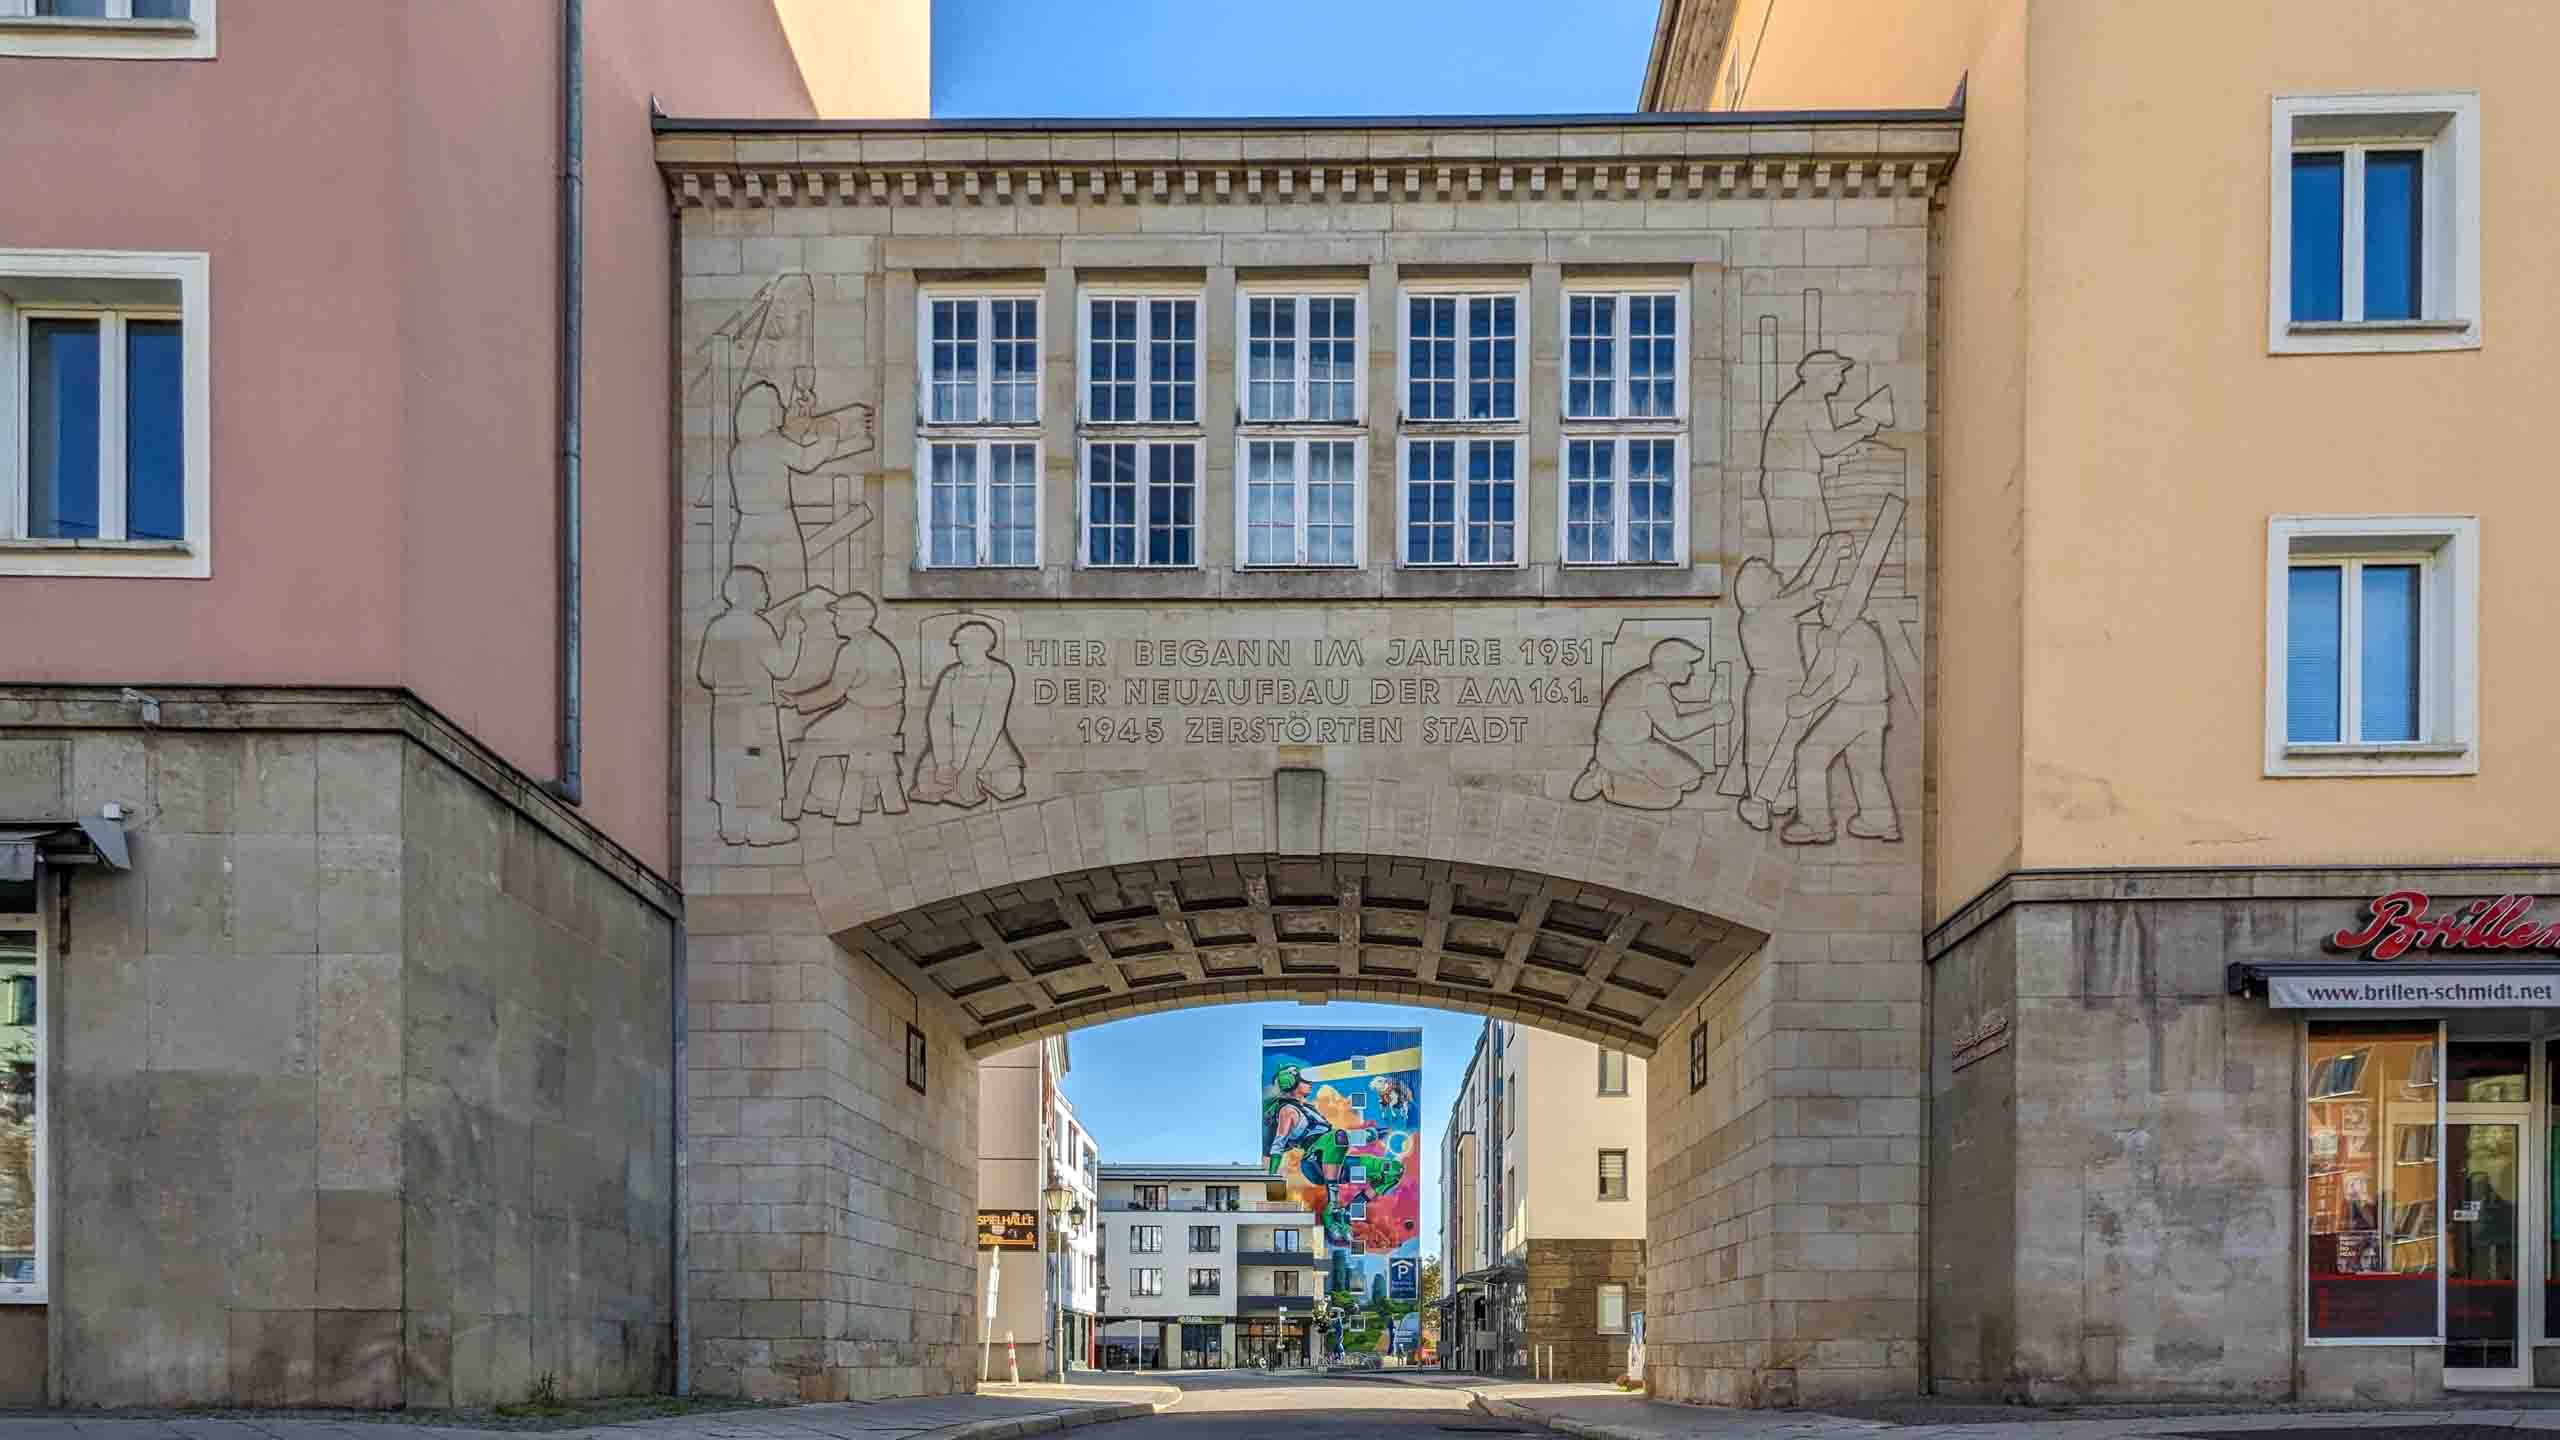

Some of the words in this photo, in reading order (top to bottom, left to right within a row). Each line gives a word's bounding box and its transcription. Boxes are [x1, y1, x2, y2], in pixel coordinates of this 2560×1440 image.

[1025, 639, 1107, 667] HIER
[1134, 639, 1291, 667] BEGANN
[1314, 639, 1364, 667] IM
[1386, 638, 1502, 667] JAHRE
[1519, 637, 1594, 666] 1951
[1033, 678, 1108, 705] DER
[1123, 678, 1350, 705] NEUAUFBAU
[1370, 677, 1441, 705] DER
[1078, 717, 1165, 744] 1945
[1185, 710, 1403, 744] ZERSTÖRTEN
[1422, 716, 1529, 744] STADT
[2307, 984, 2552, 1001] www.brillen-schmidt.net
